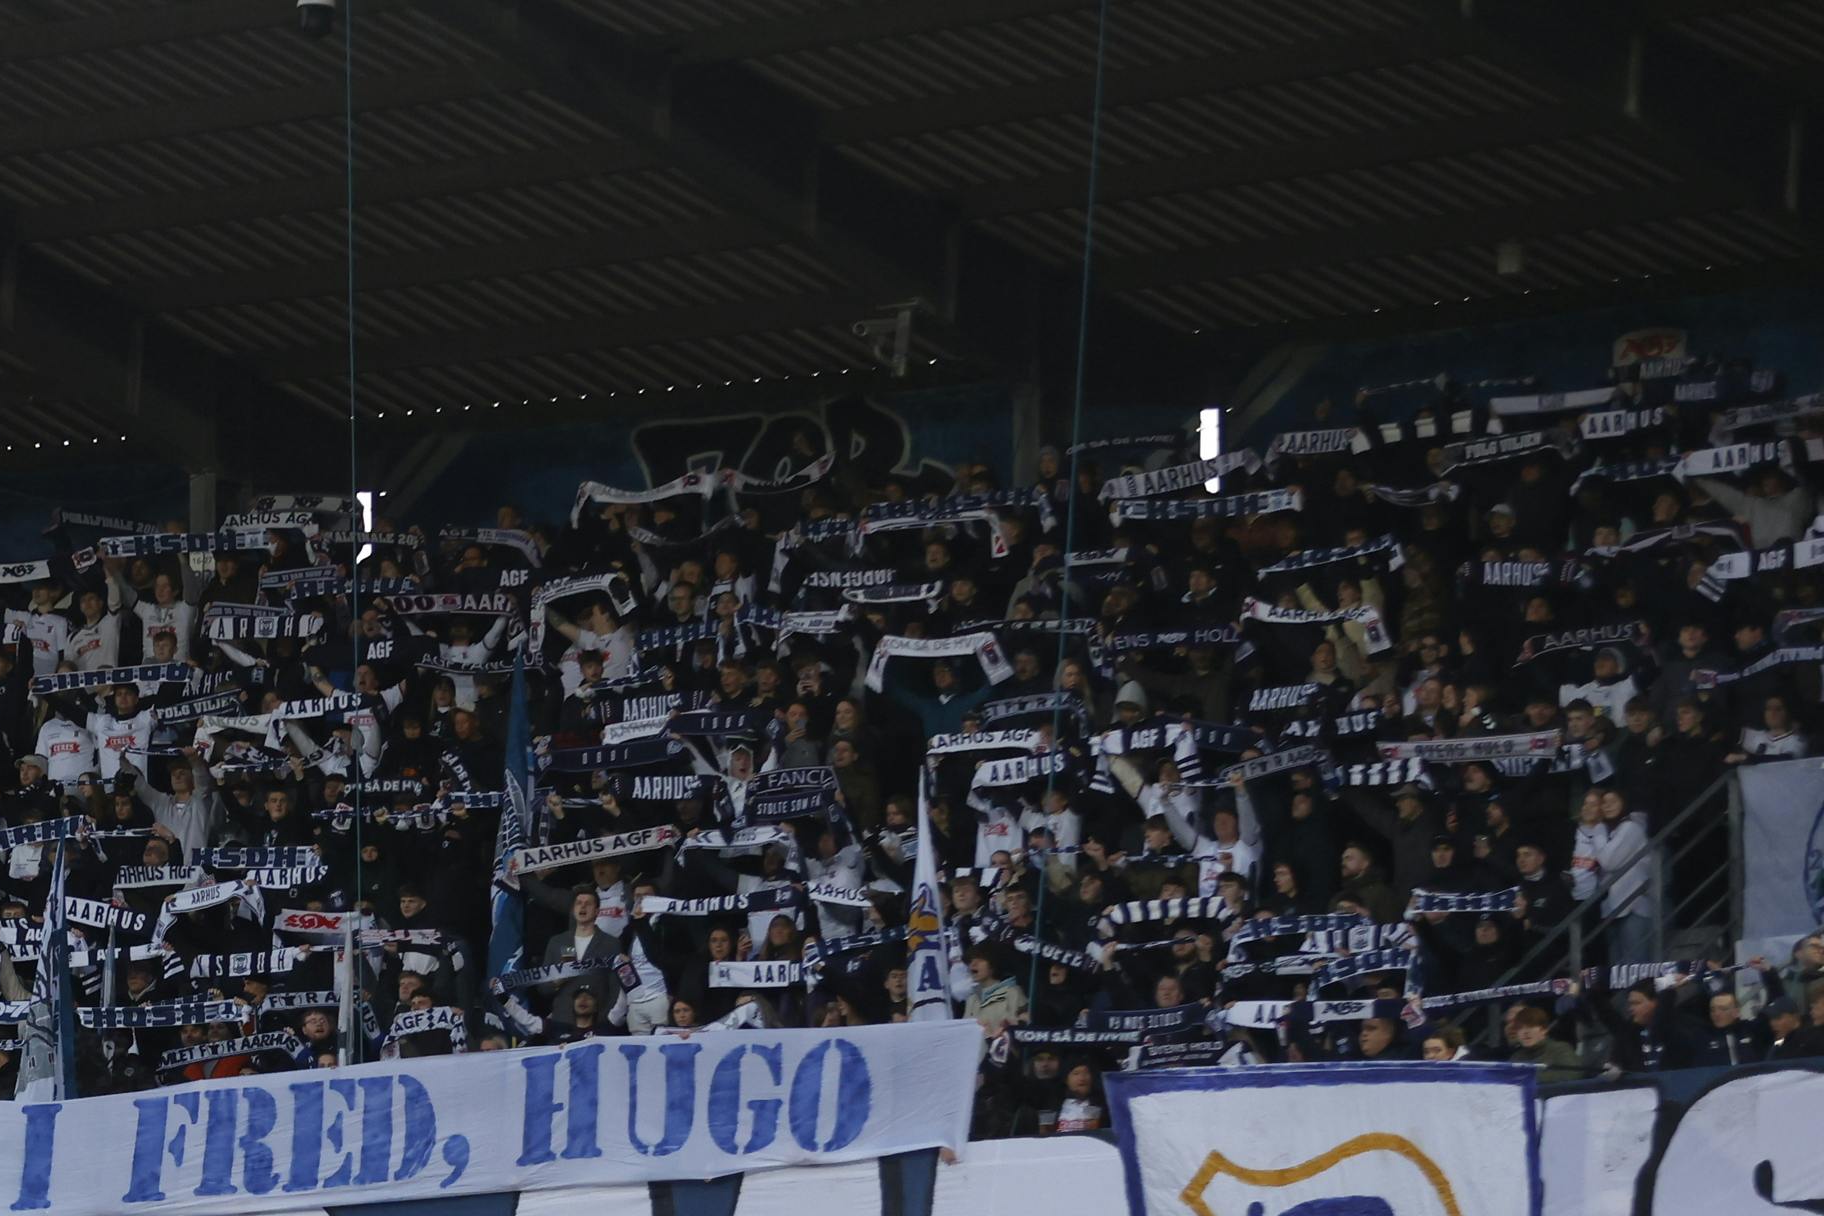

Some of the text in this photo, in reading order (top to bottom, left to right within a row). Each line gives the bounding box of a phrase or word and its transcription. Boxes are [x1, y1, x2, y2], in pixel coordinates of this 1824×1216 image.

[1588, 408, 1664, 437] AARHUS
[1285, 429, 1349, 454] AARHUS
[1712, 443, 1785, 468] AARHUS
[1145, 464, 1218, 497] AARHUS
[1756, 549, 1786, 571] AGF
[500, 569, 529, 587] AGF
[1483, 561, 1544, 586] AARHUS
[1543, 623, 1637, 648] AARHUS
[367, 640, 394, 660] AGF
[284, 694, 362, 716] AARHUS
[1248, 682, 1313, 711] AARHUS
[1131, 728, 1160, 748] AGF
[991, 754, 1065, 782] AARHUS
[632, 775, 696, 798] AARHUS
[523, 829, 653, 866] AARHUS AGF
[255, 865, 328, 887] AARHUS
[190, 886, 220, 905] AARHUS
[666, 893, 749, 915] AARHUS
[68, 897, 146, 931] AARHUS
[395, 1012, 426, 1033] AGF
[243, 1032, 301, 1052] AARHUS
[14, 1102, 63, 1210] I
[124, 1074, 472, 1201] FRED,
[516, 1038, 873, 1163] HUGO
